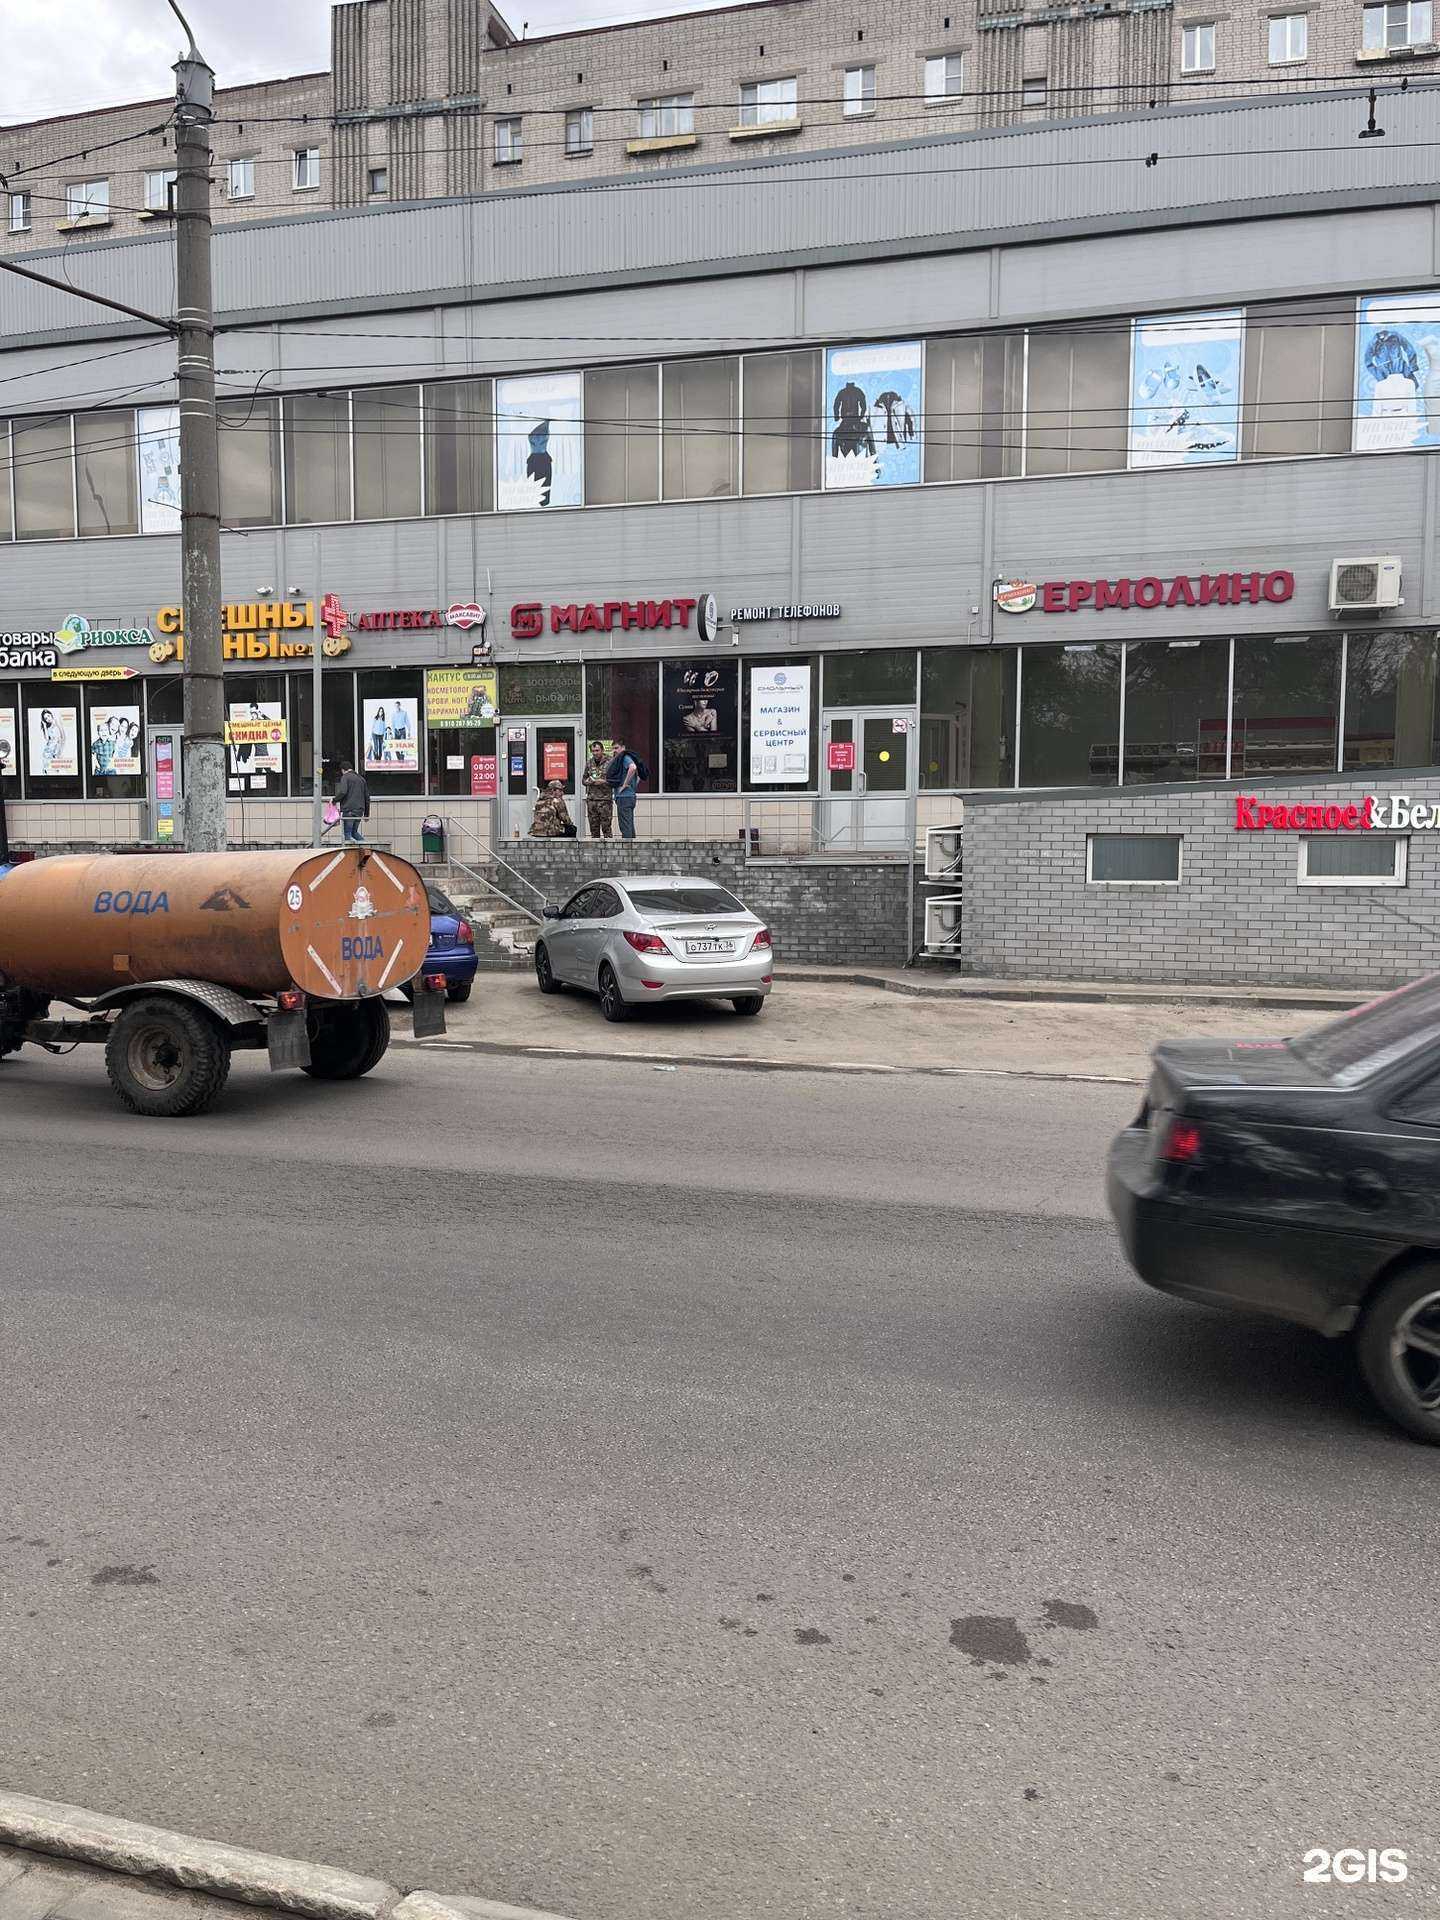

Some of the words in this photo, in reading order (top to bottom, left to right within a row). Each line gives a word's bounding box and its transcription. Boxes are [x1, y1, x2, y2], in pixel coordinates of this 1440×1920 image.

[1043, 570, 1295, 612] ЕРМОЛИНО
[359, 610, 444, 630] АПТЕКА
[551, 598, 696, 633] МАГНИТ
[731, 606, 772, 620] РЕМОНТ
[779, 603, 841, 618] ТЕЛЕФОНОВ
[59, 670, 99, 678] следующую
[101, 669, 122, 677] дверь
[760, 706, 800, 714] МАГАЗИН
[753, 728, 807, 737] СЕРВИСНЫЙ
[765, 739, 794, 747] ЦЕНТР
[94, 890, 169, 914] ВОДА
[289, 889, 300, 905] 25
[342, 936, 384, 960] ВОДА
